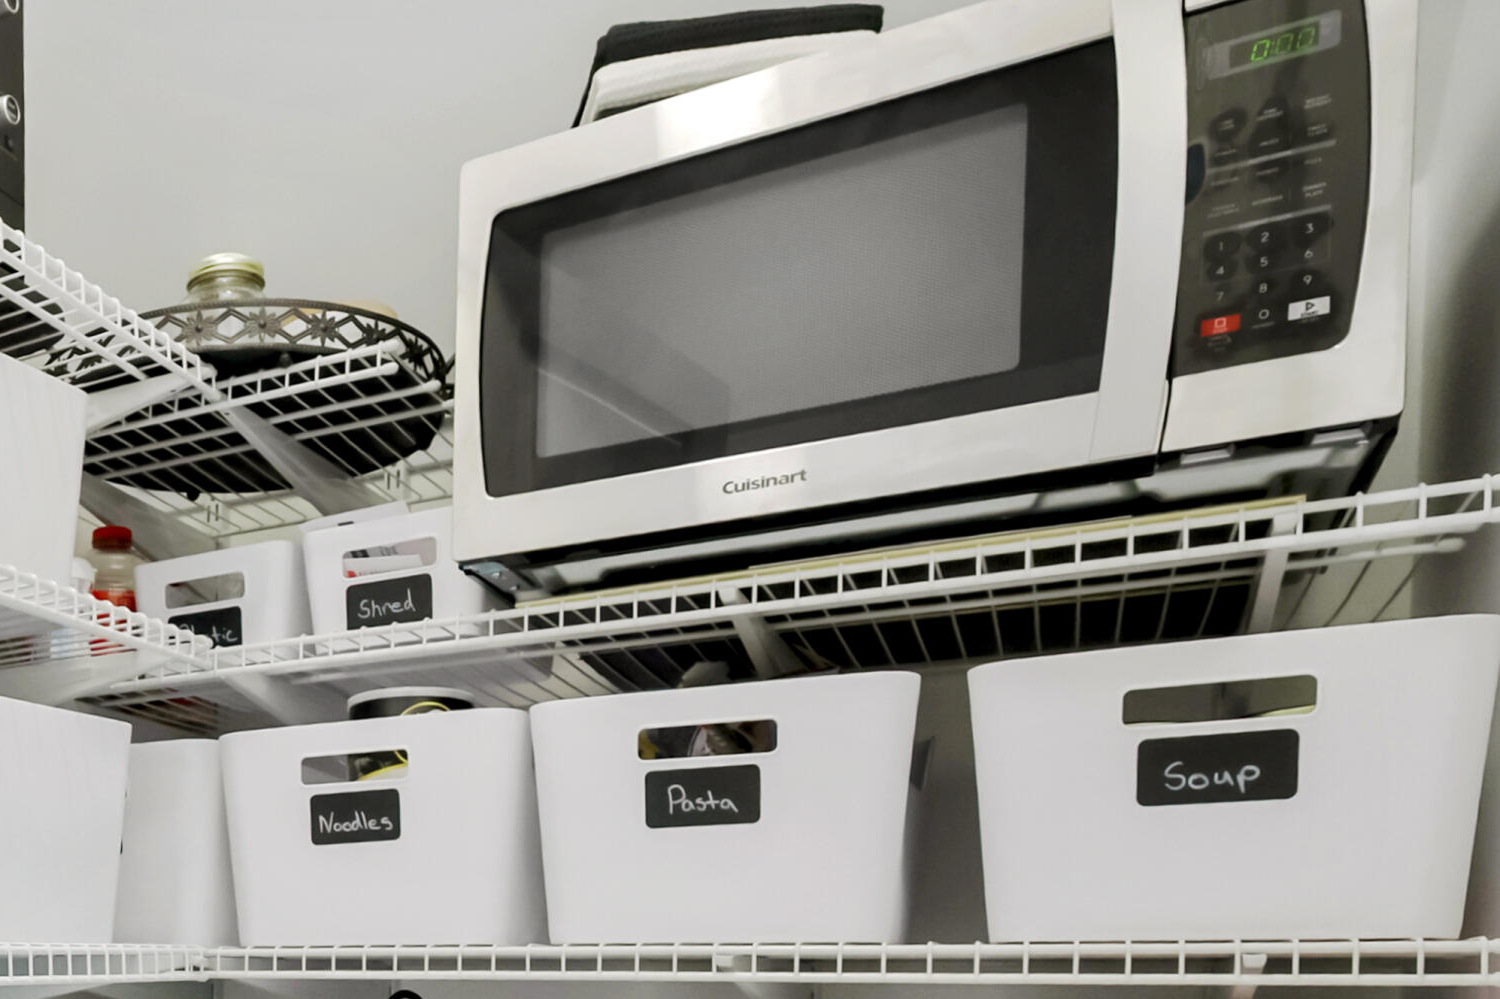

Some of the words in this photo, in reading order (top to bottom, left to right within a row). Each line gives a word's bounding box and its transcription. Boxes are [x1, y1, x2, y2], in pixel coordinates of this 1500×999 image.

[1260, 231, 1270, 243] 2
[1305, 222, 1314, 234] 3
[1215, 265, 1225, 275] 4
[1260, 256, 1269, 268] 5
[1259, 282, 1268, 293] 8
[1303, 274, 1313, 285] 9
[722, 469, 808, 494] Cuisinart
[357, 587, 417, 619] Shred
[1164, 760, 1261, 794] Soup
[666, 783, 739, 815] Pasta
[318, 811, 394, 834] Noodles
